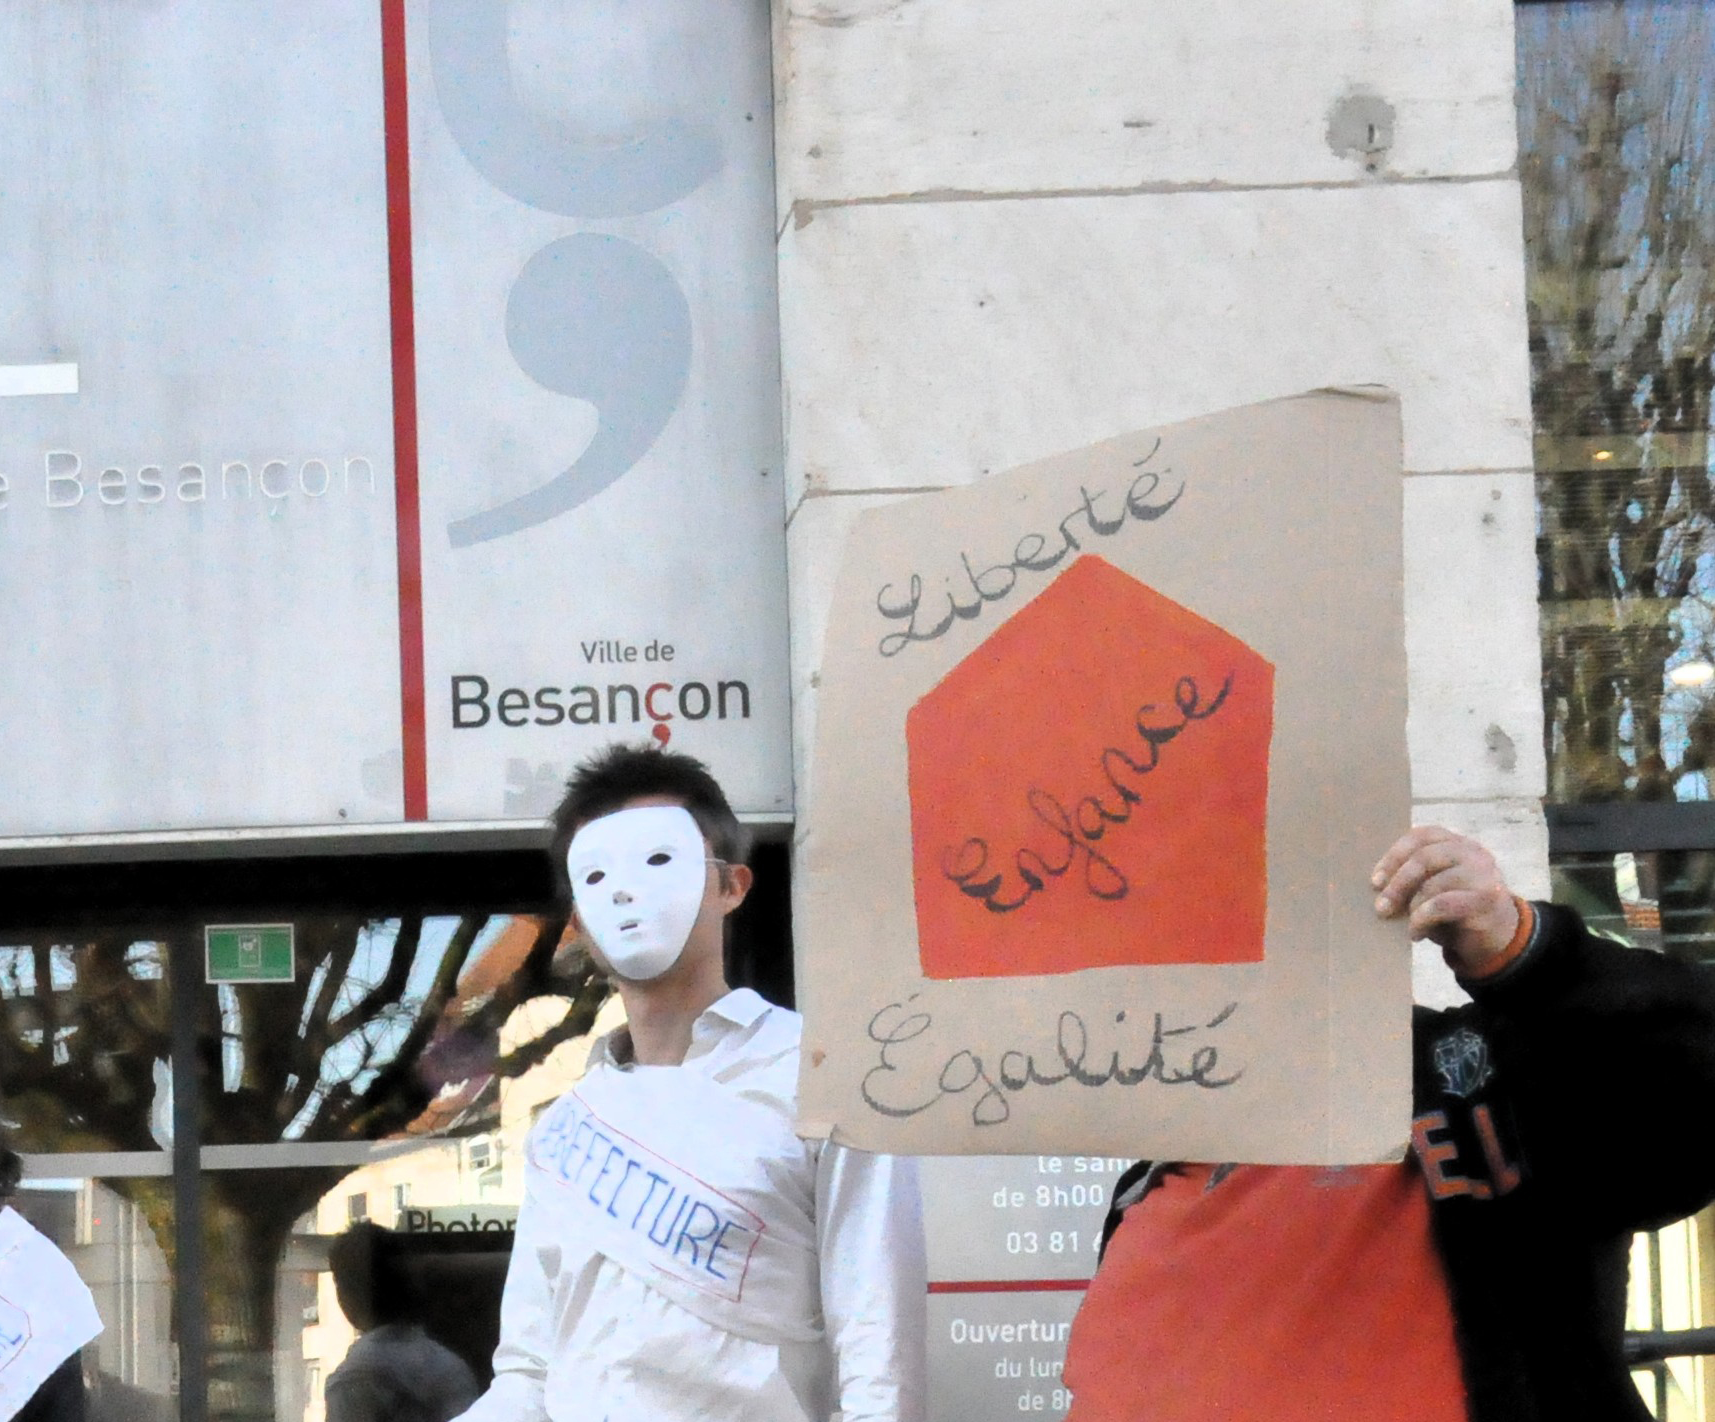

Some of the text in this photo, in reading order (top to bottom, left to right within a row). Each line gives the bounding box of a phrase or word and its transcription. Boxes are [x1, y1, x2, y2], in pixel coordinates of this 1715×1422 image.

[44, 449, 378, 516] Besançon
[875, 437, 1186, 658] Liberté
[580, 639, 676, 664] Ville de
[450, 674, 751, 748] Besançon
[941, 669, 1236, 914] Enfance
[860, 993, 1246, 1126] Égalité
[1037, 1155, 1138, 1173] le sam
[992, 1184, 1104, 1208] de 8h00
[1006, 1231, 1039, 1254] 03
[1049, 1231, 1079, 1254] 81
[994, 1357, 1022, 1378] du
[1017, 1389, 1044, 1411] de
